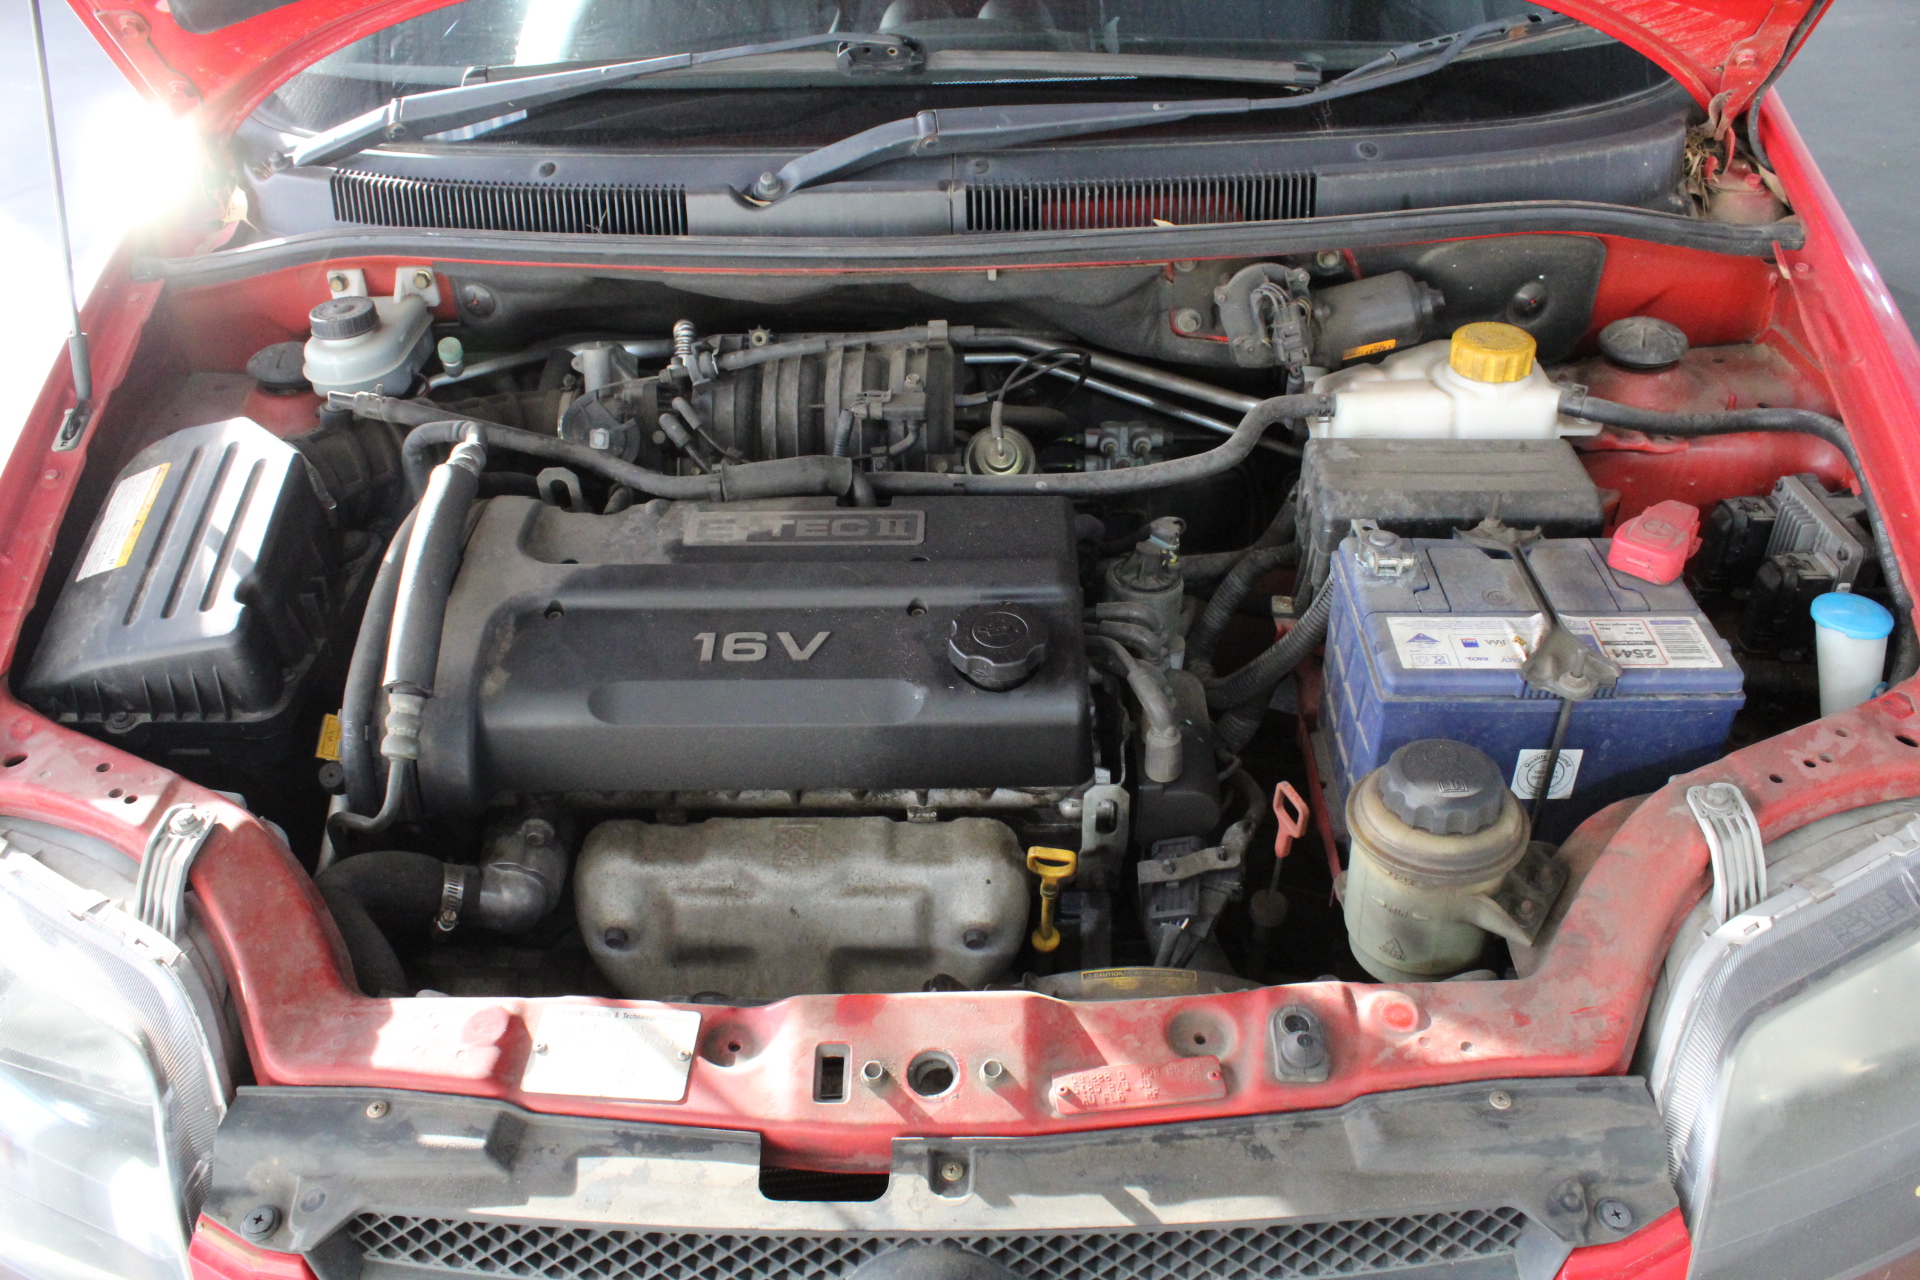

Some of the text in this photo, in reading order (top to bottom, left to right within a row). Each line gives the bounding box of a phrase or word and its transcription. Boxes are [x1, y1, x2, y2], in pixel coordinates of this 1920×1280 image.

[697, 518, 870, 538] E-TEC
[693, 631, 831, 662] 16V
[1611, 648, 1657, 659] 2541
[1524, 754, 1548, 768] Quality
[622, 1012, 658, 1022] Technology
